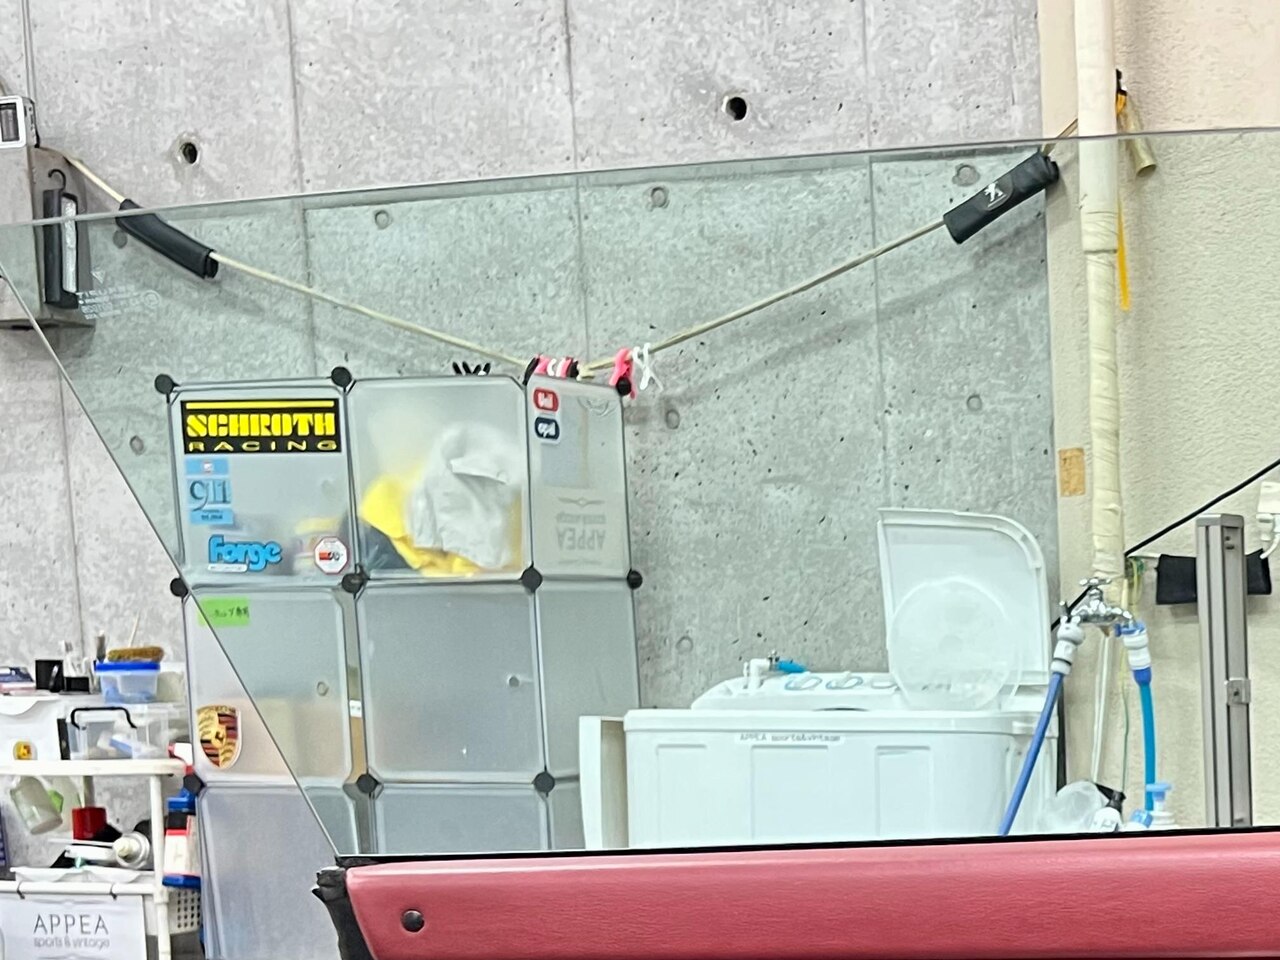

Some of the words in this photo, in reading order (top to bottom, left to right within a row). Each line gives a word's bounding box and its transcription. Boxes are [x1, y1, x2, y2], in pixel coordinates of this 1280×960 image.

[187, 413, 336, 437] SCHROTH
[189, 440, 338, 452] RACING
[190, 480, 231, 511] 911
[208, 534, 283, 572] Forge
[33, 913, 109, 935] APPEA
